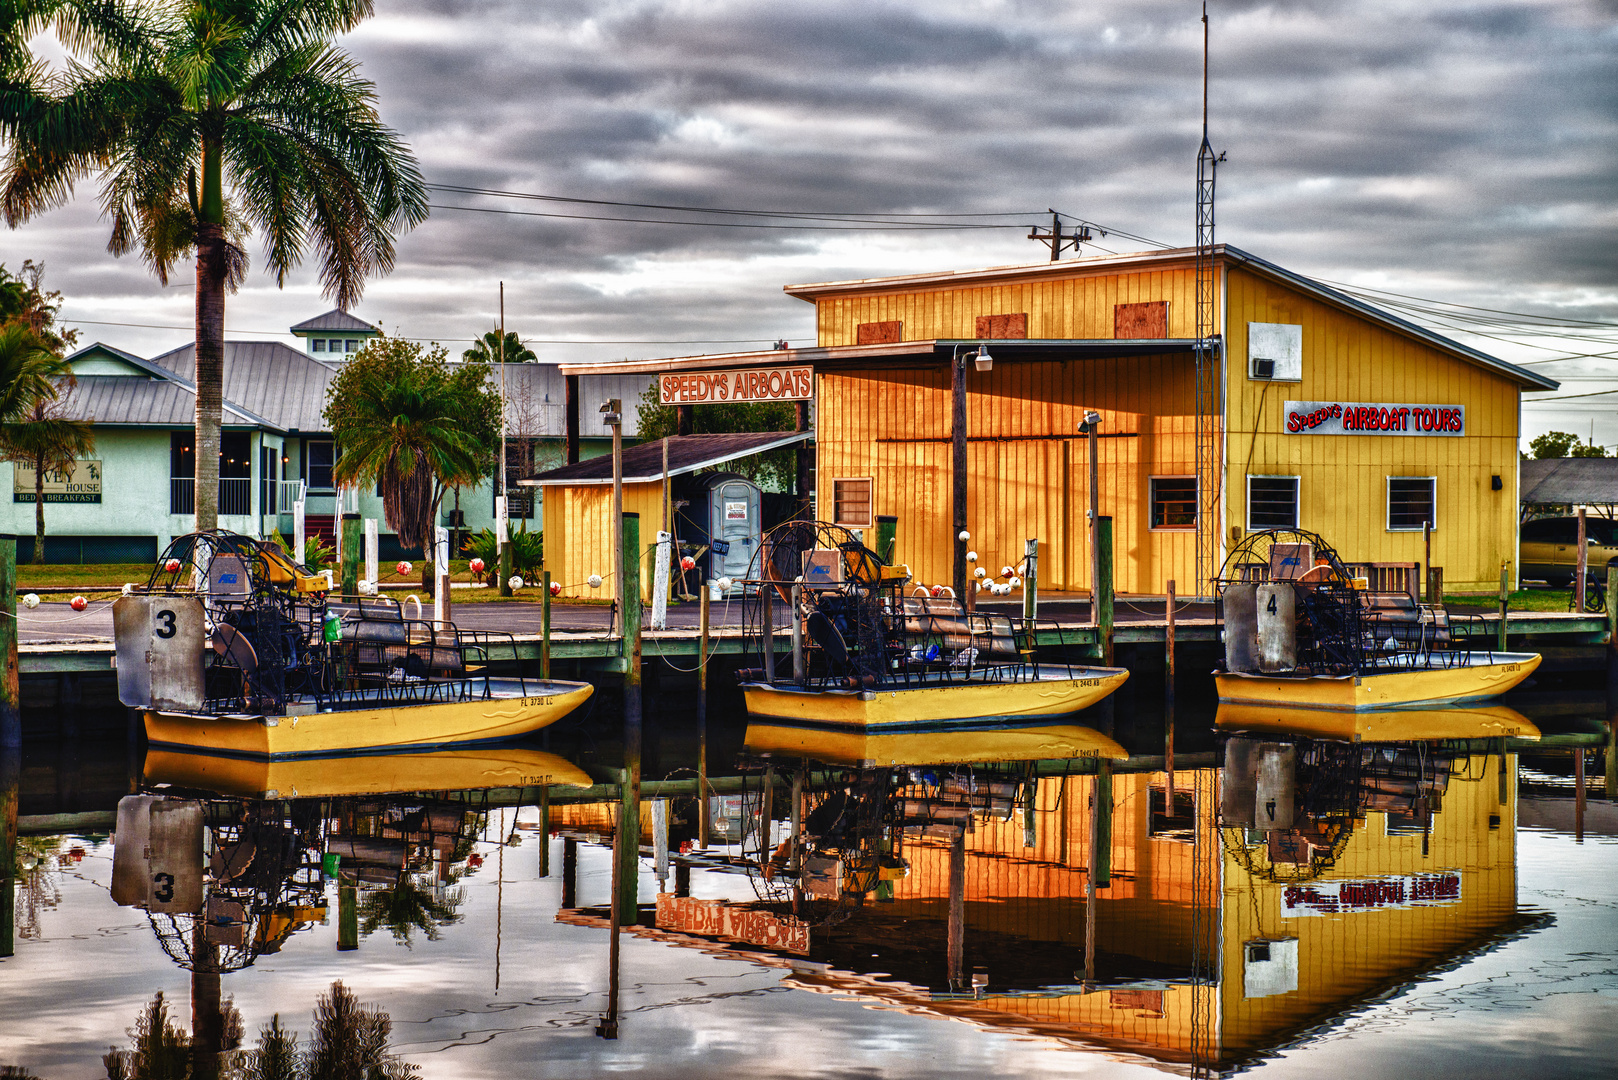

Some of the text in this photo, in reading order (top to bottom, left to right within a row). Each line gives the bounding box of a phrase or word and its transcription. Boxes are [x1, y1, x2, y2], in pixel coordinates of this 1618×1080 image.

[662, 369, 811, 402] SPEEDY'S AIRBOATS
[1287, 404, 1463, 432] SPEEDY'S AIRBOAT TOURS
[47, 494, 96, 502] BREAKFAST
[66, 483, 99, 492] HOUSE
[794, 595, 800, 620] 5
[1266, 594, 1277, 616] 4
[156, 609, 177, 639] 3
